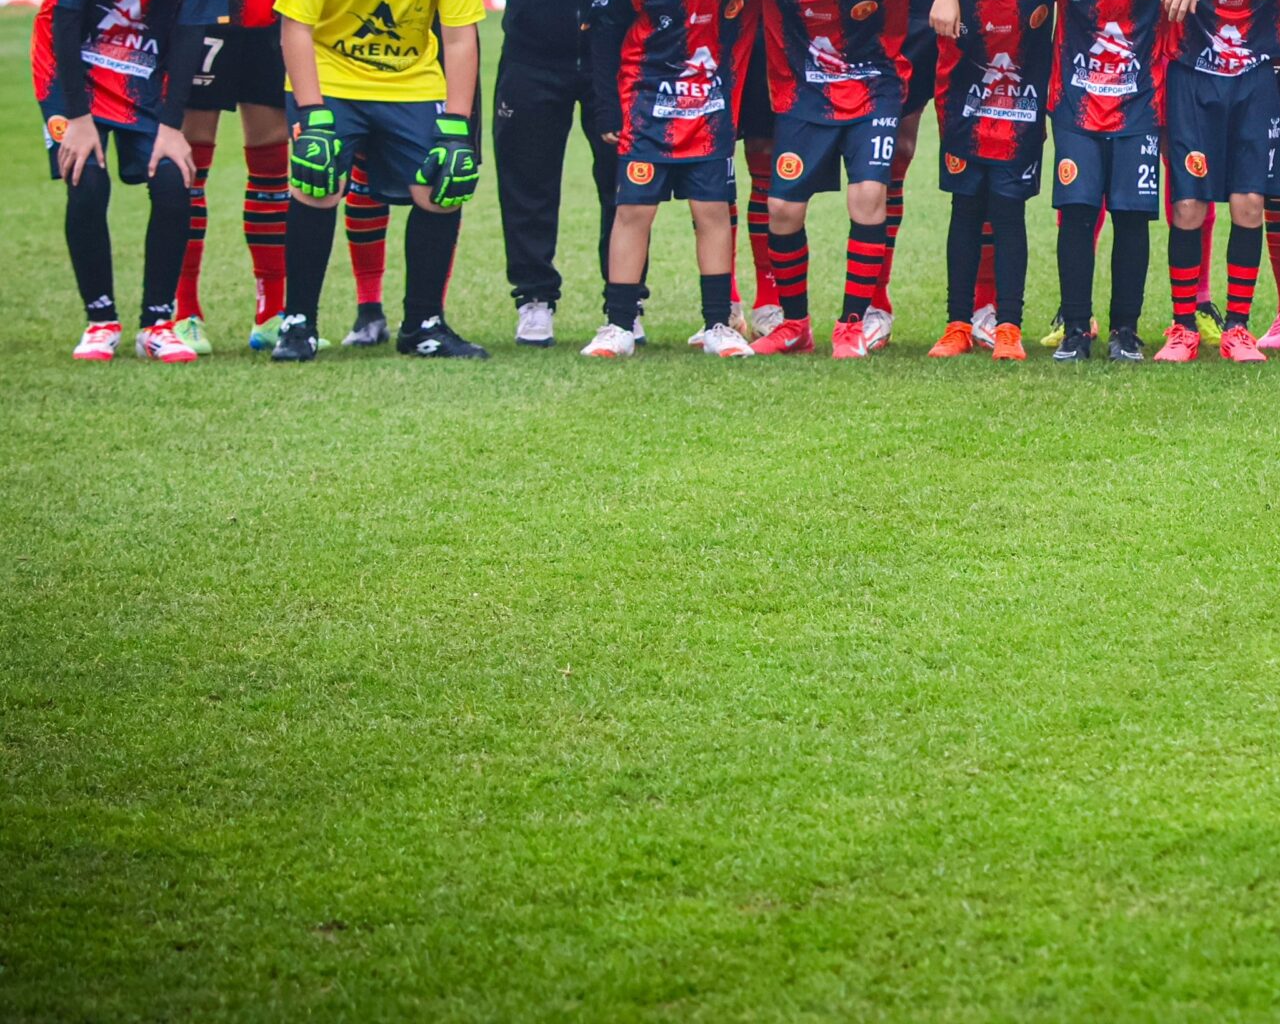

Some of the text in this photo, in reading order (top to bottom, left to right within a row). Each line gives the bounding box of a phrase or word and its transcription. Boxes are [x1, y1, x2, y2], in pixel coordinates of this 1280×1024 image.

[203, 37, 224, 73] 7
[332, 40, 419, 57] ARENA
[993, 109, 1032, 120] DEPORTIVO
[871, 136, 894, 160] 16
